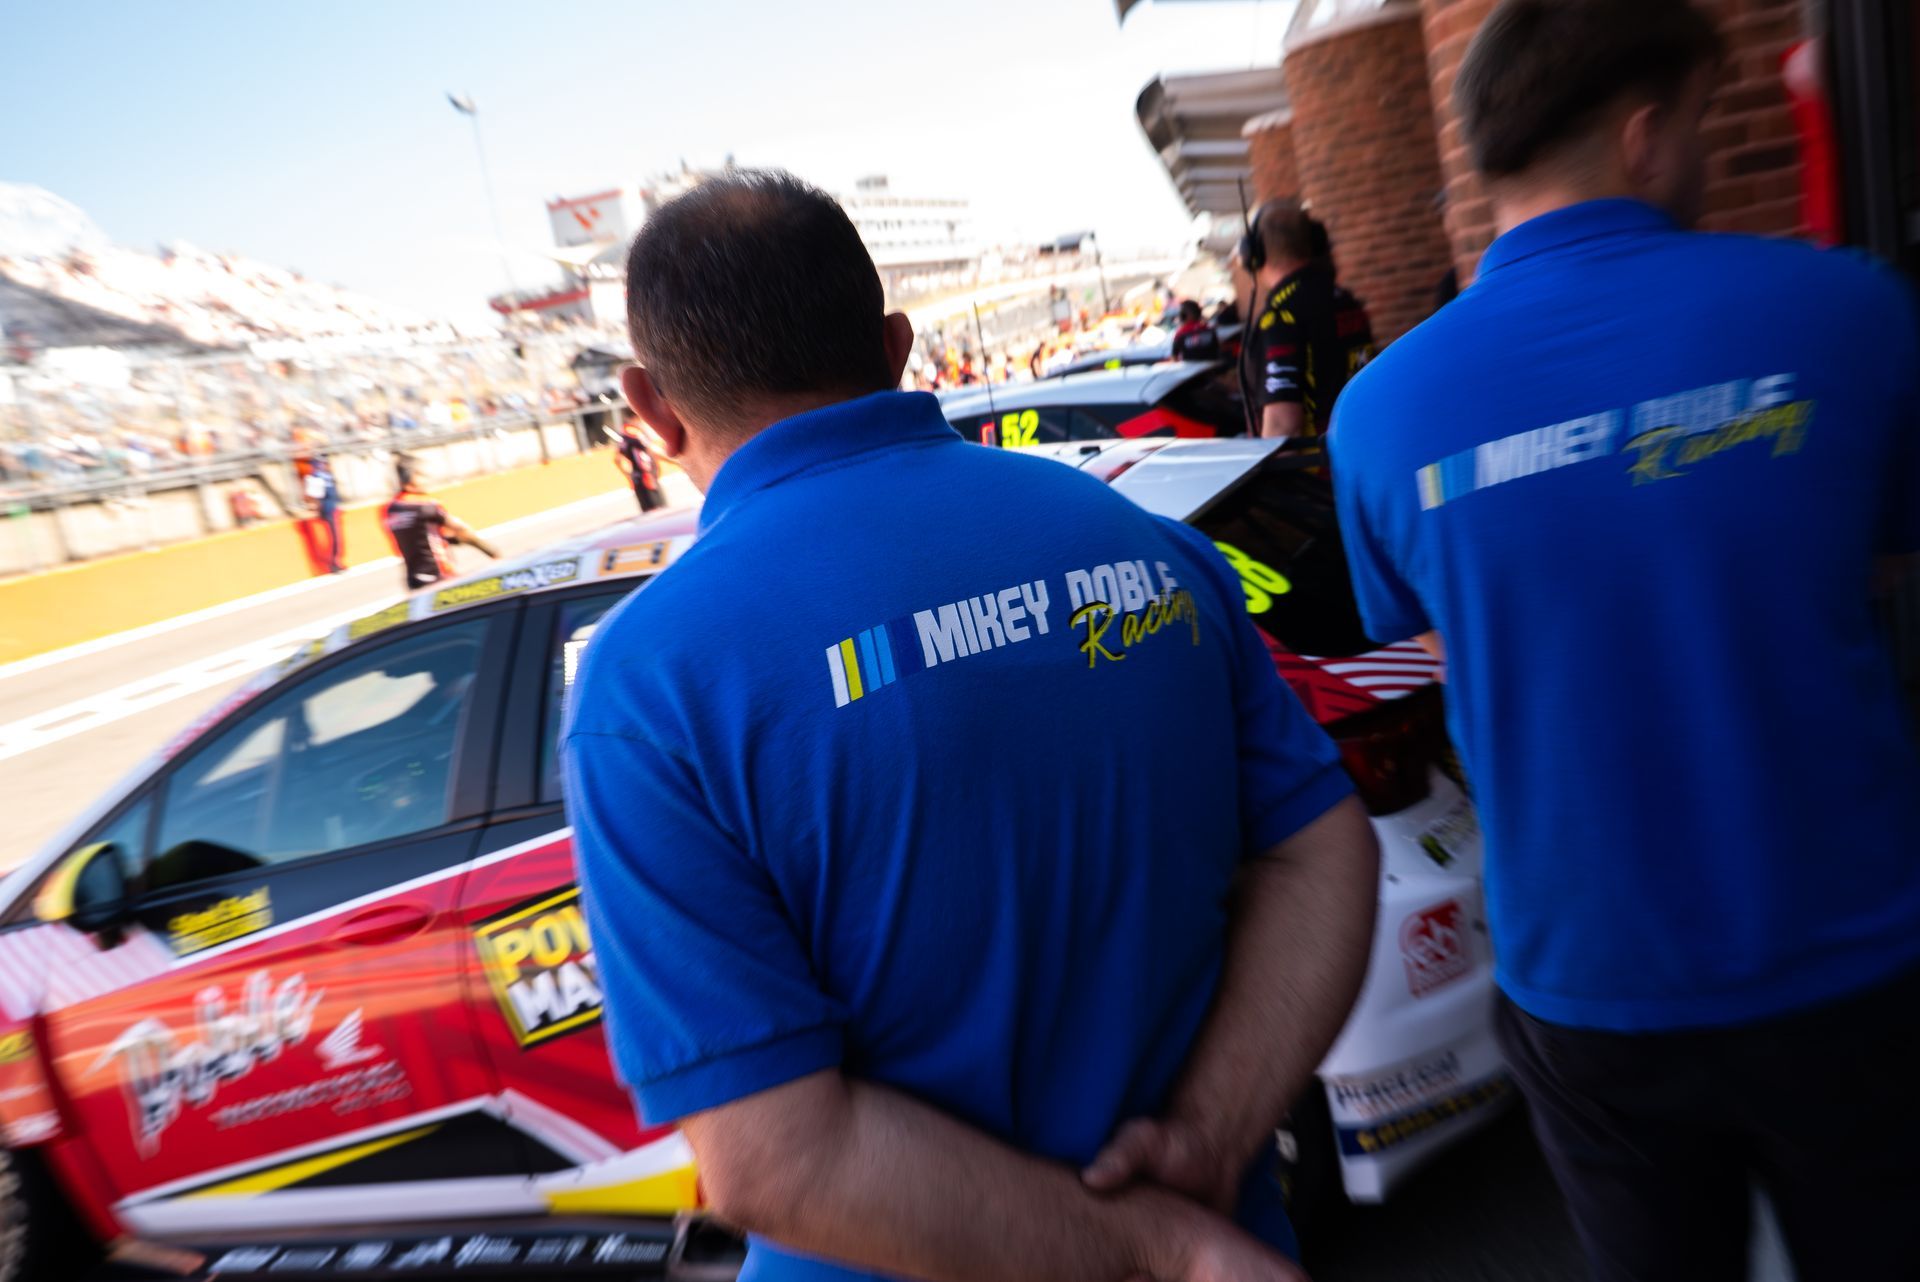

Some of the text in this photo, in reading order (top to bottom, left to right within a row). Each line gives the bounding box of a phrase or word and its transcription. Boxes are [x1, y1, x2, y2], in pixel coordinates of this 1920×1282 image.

[1002, 409, 1040, 450] 52
[912, 559, 1180, 668] MIKEY DOBLE
[1070, 586, 1200, 669] Racing
